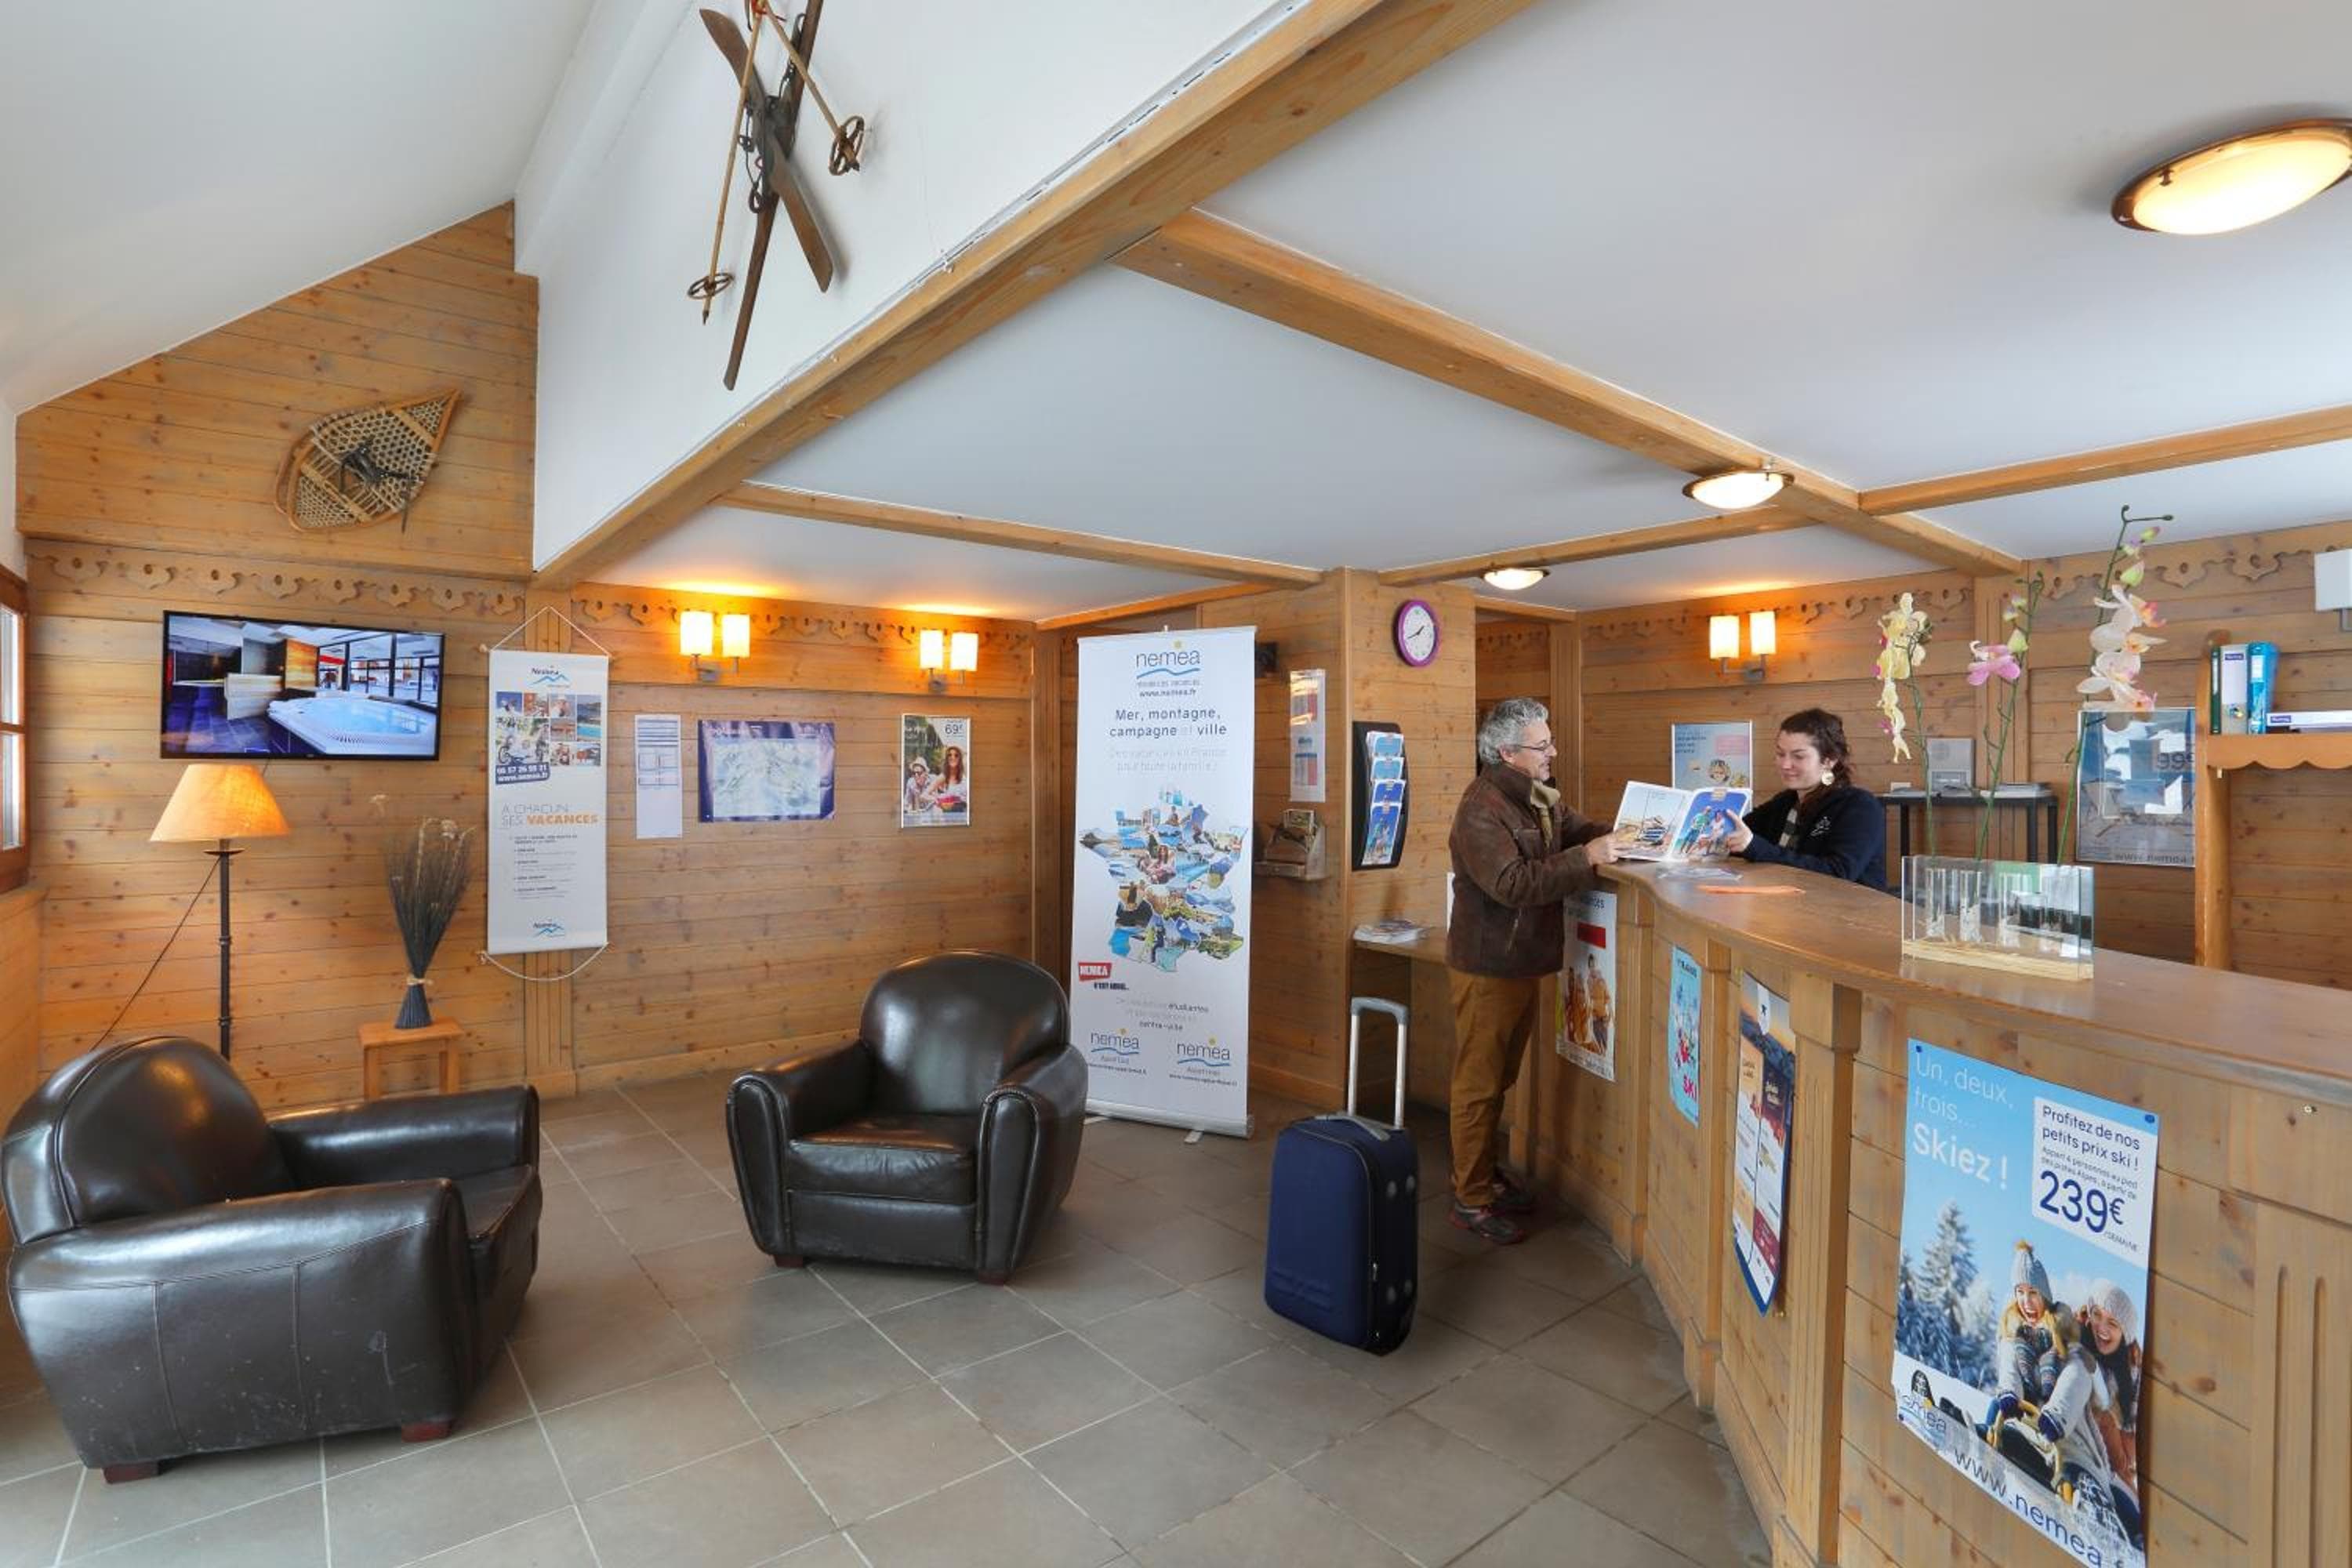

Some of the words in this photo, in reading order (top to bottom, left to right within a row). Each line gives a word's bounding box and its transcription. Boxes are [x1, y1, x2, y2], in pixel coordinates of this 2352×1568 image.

[1136, 650, 1201, 667] nemea
[1116, 709, 1145, 721] Mer,
[1149, 709, 1221, 721] montagne,
[1109, 725, 1177, 739] campagne
[1197, 724, 1227, 735] ville
[527, 814, 599, 825] VACANCES
[1091, 1033, 1139, 1049] nemea
[1177, 1042, 1230, 1061] nemea
[1915, 1054, 1948, 1087] Un,
[1955, 1068, 2014, 1109] deux,
[2042, 1105, 2092, 1134] Profitez
[2096, 1123, 2112, 1141] de
[2115, 1133, 2140, 1150] nos
[1913, 1122, 1991, 1183] Skiez
[2000, 1155, 2009, 1190] !
[2042, 1127, 2079, 1149] petits
[2082, 1142, 2107, 1160] prix
[2111, 1151, 2130, 1167] ski
[2134, 1156, 2139, 1172] !
[2039, 1170, 2125, 1233] 239€
[1898, 1393, 1947, 1432] emea
